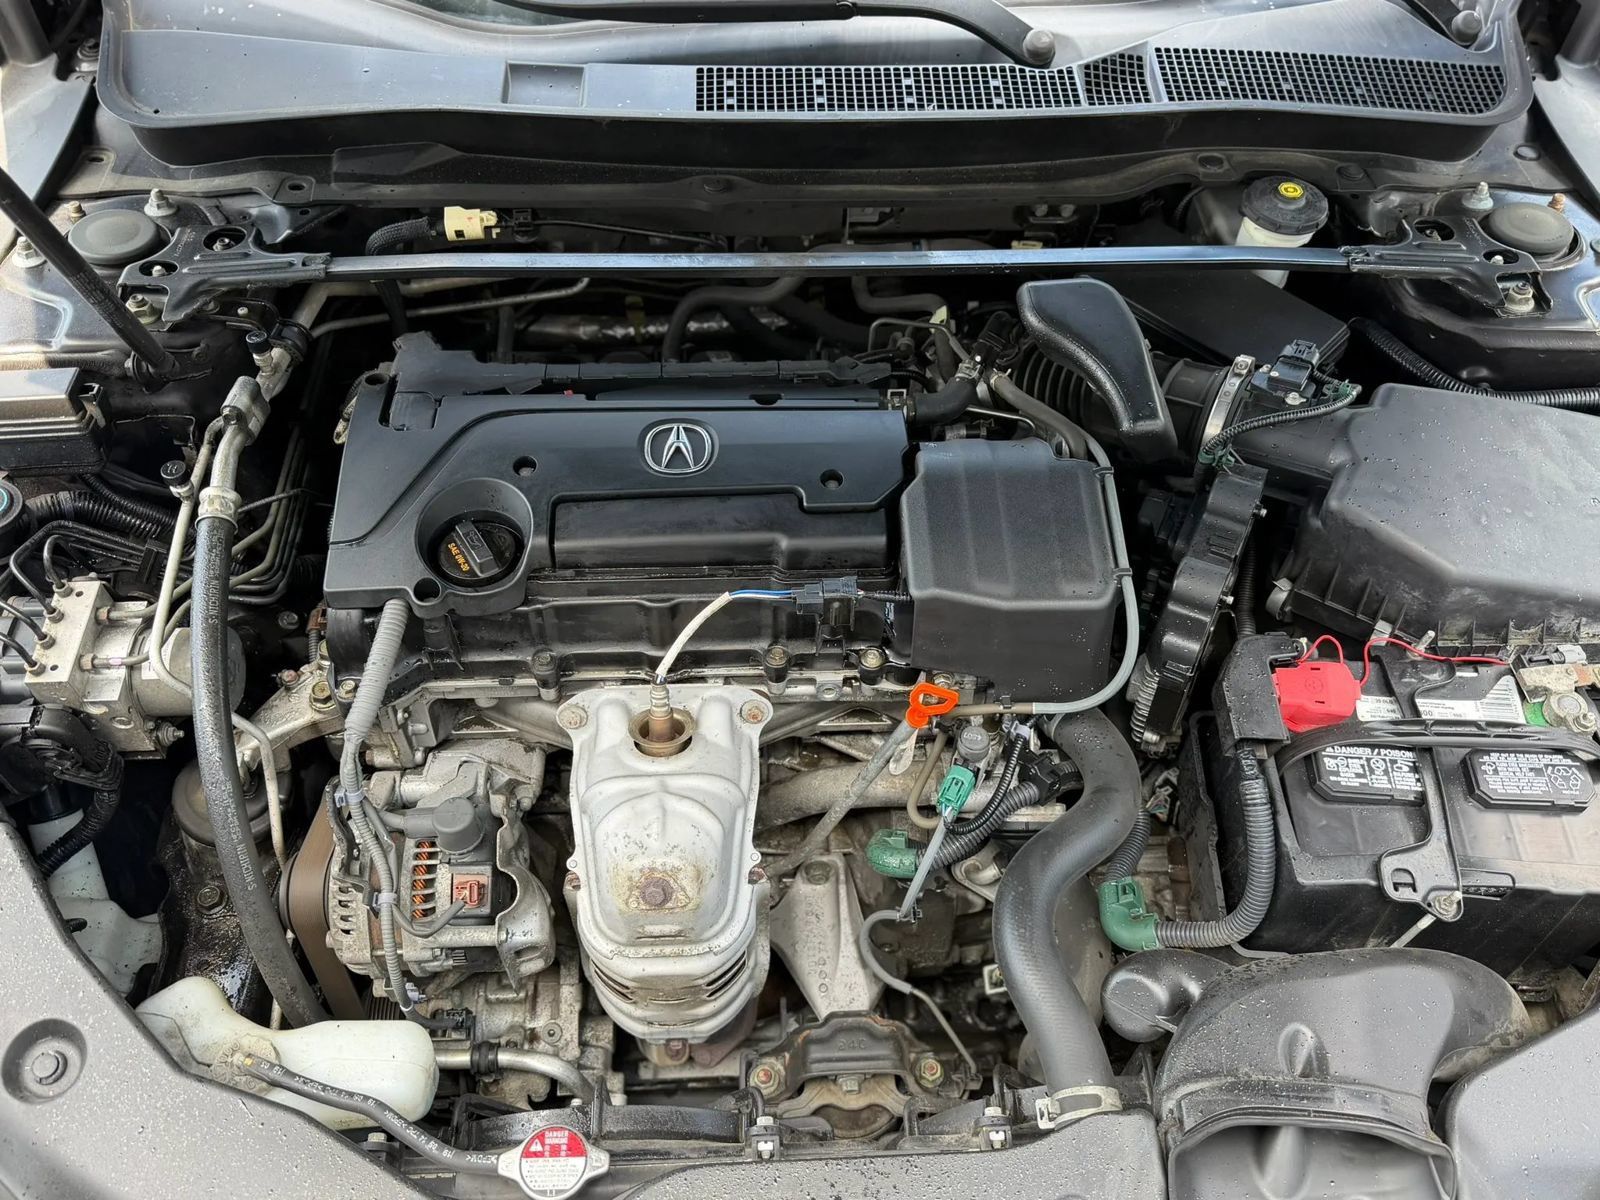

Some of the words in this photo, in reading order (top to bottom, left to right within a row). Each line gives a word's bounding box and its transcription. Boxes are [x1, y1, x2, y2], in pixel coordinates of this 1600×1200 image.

[447, 542, 460, 557] SAE
[1333, 745, 1372, 756] DANGER
[1372, 748, 1379, 756] /
[1380, 748, 1414, 759] POISON
